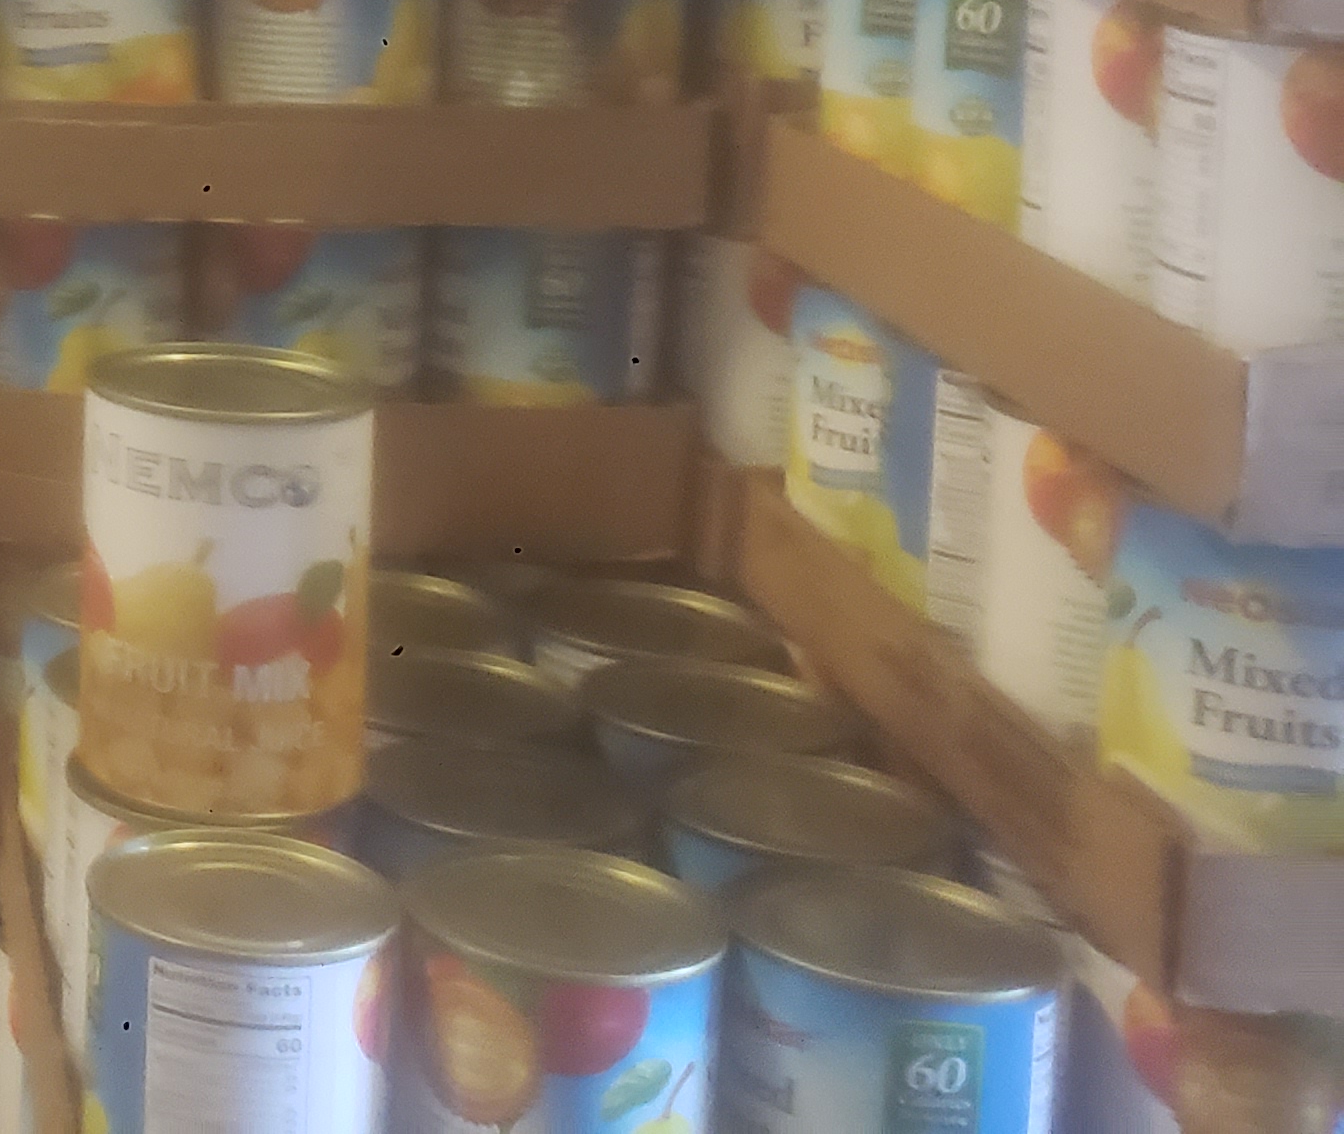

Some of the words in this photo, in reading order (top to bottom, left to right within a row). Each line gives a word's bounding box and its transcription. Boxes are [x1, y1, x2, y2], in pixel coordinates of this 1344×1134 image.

[1192, 686, 1341, 750] Fruits
[276, 1037, 302, 1054] 60
[907, 1052, 968, 1094] 60
